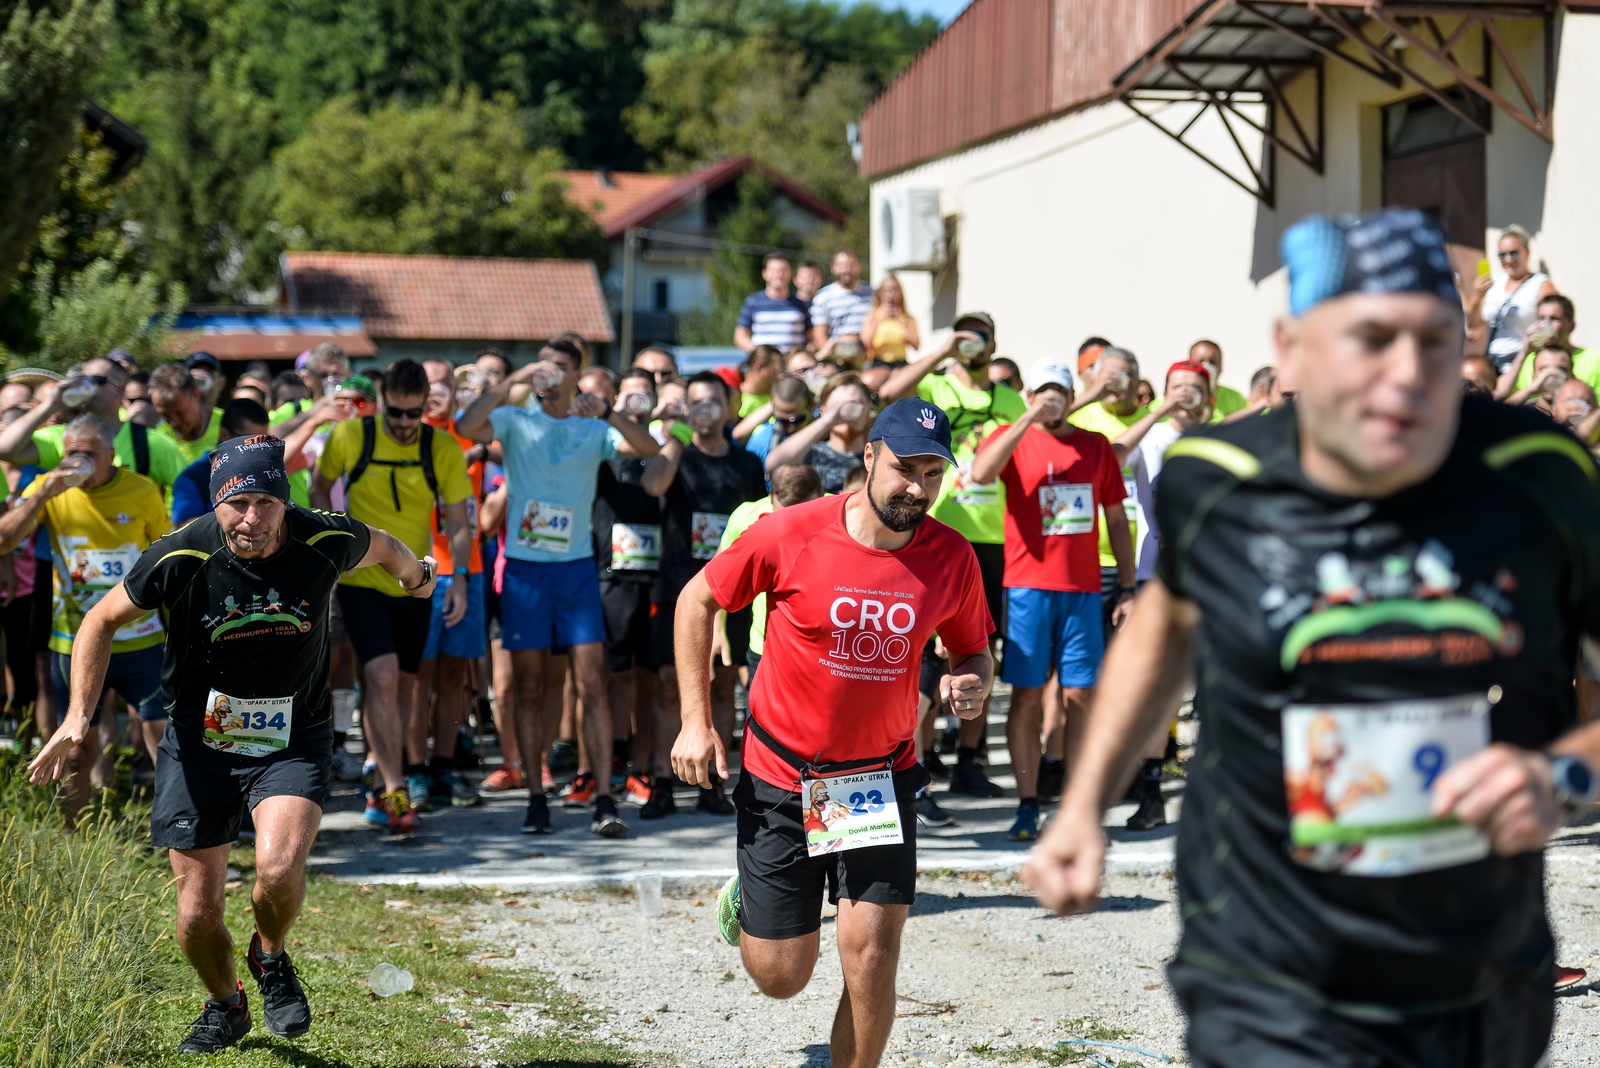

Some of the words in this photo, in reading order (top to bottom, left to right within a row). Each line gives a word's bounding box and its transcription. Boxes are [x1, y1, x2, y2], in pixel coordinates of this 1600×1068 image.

[1074, 495, 1083, 510] 4
[547, 516, 568, 531] 49
[641, 535, 655, 549] 71
[102, 561, 123, 577] 33
[829, 596, 916, 635] CRO
[828, 629, 911, 664] 100
[830, 669, 873, 681] ULTRAMARATONU
[853, 666, 882, 674] PRVENSTVO
[271, 698, 291, 706] UTRKA
[240, 711, 287, 731] 134
[1413, 743, 1444, 793] 9
[841, 775, 868, 784] "OPAKA"
[868, 772, 890, 781] UTRKA
[849, 789, 886, 817] 23
[848, 825, 868, 835] David
[869, 822, 896, 831] Markan
